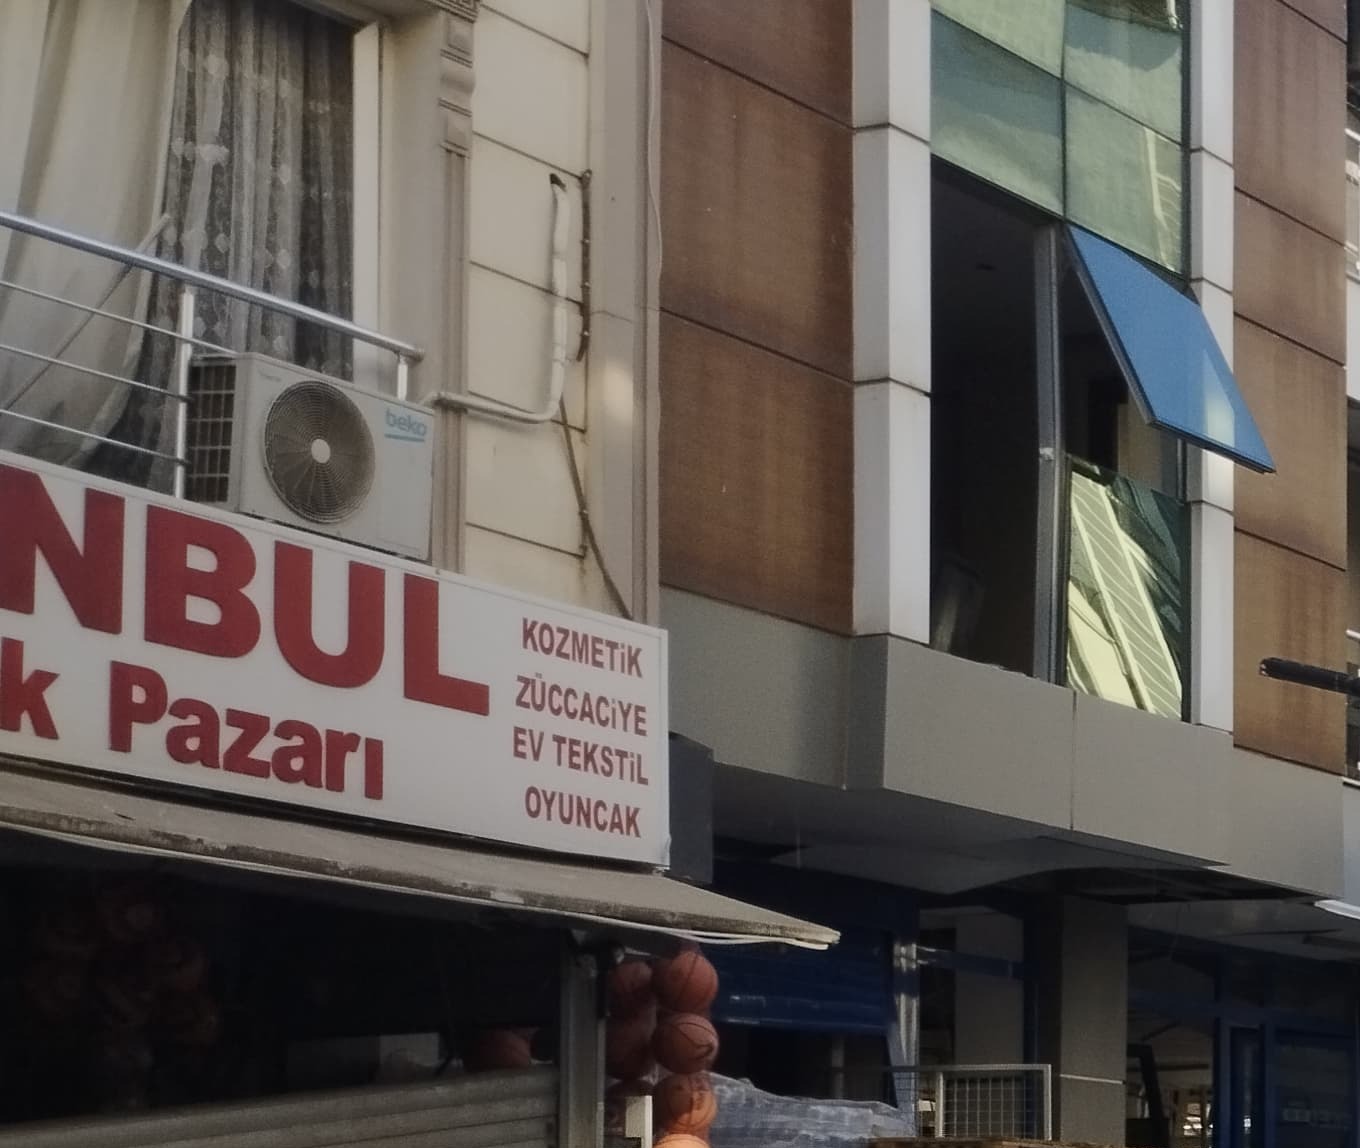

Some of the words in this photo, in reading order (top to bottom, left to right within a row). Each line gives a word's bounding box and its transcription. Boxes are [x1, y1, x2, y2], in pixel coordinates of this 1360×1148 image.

[386, 408, 427, 437] beko
[0, 462, 489, 716] NBUL
[109, 660, 384, 799] Pazarı
[513, 726, 544, 762] EV
[524, 785, 641, 838] OYUNCAK
